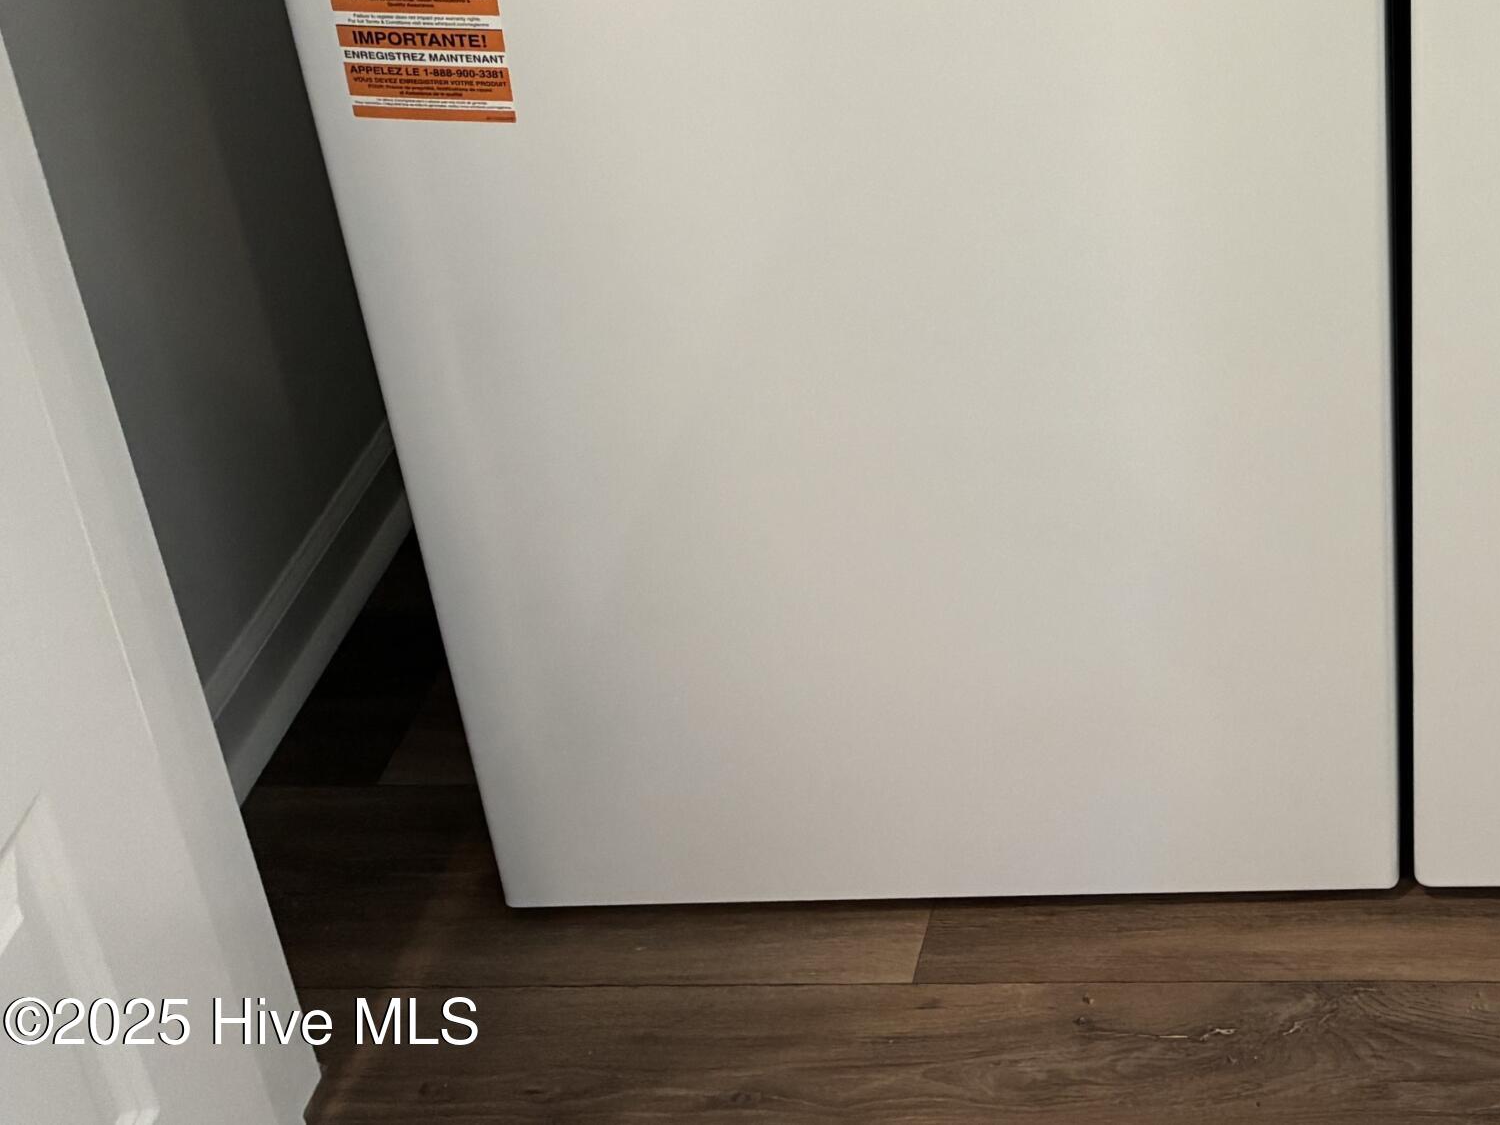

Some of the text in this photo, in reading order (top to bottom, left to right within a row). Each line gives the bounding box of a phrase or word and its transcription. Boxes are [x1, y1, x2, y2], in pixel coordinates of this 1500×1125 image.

[352, 30, 487, 48] IMPORTANTE!
[344, 50, 505, 64] ENREGISTREZ MAINTENANT
[350, 65, 504, 79] APPELEZ LE 1-888-900-3381
[475, 80, 506, 88] PRODUIT
